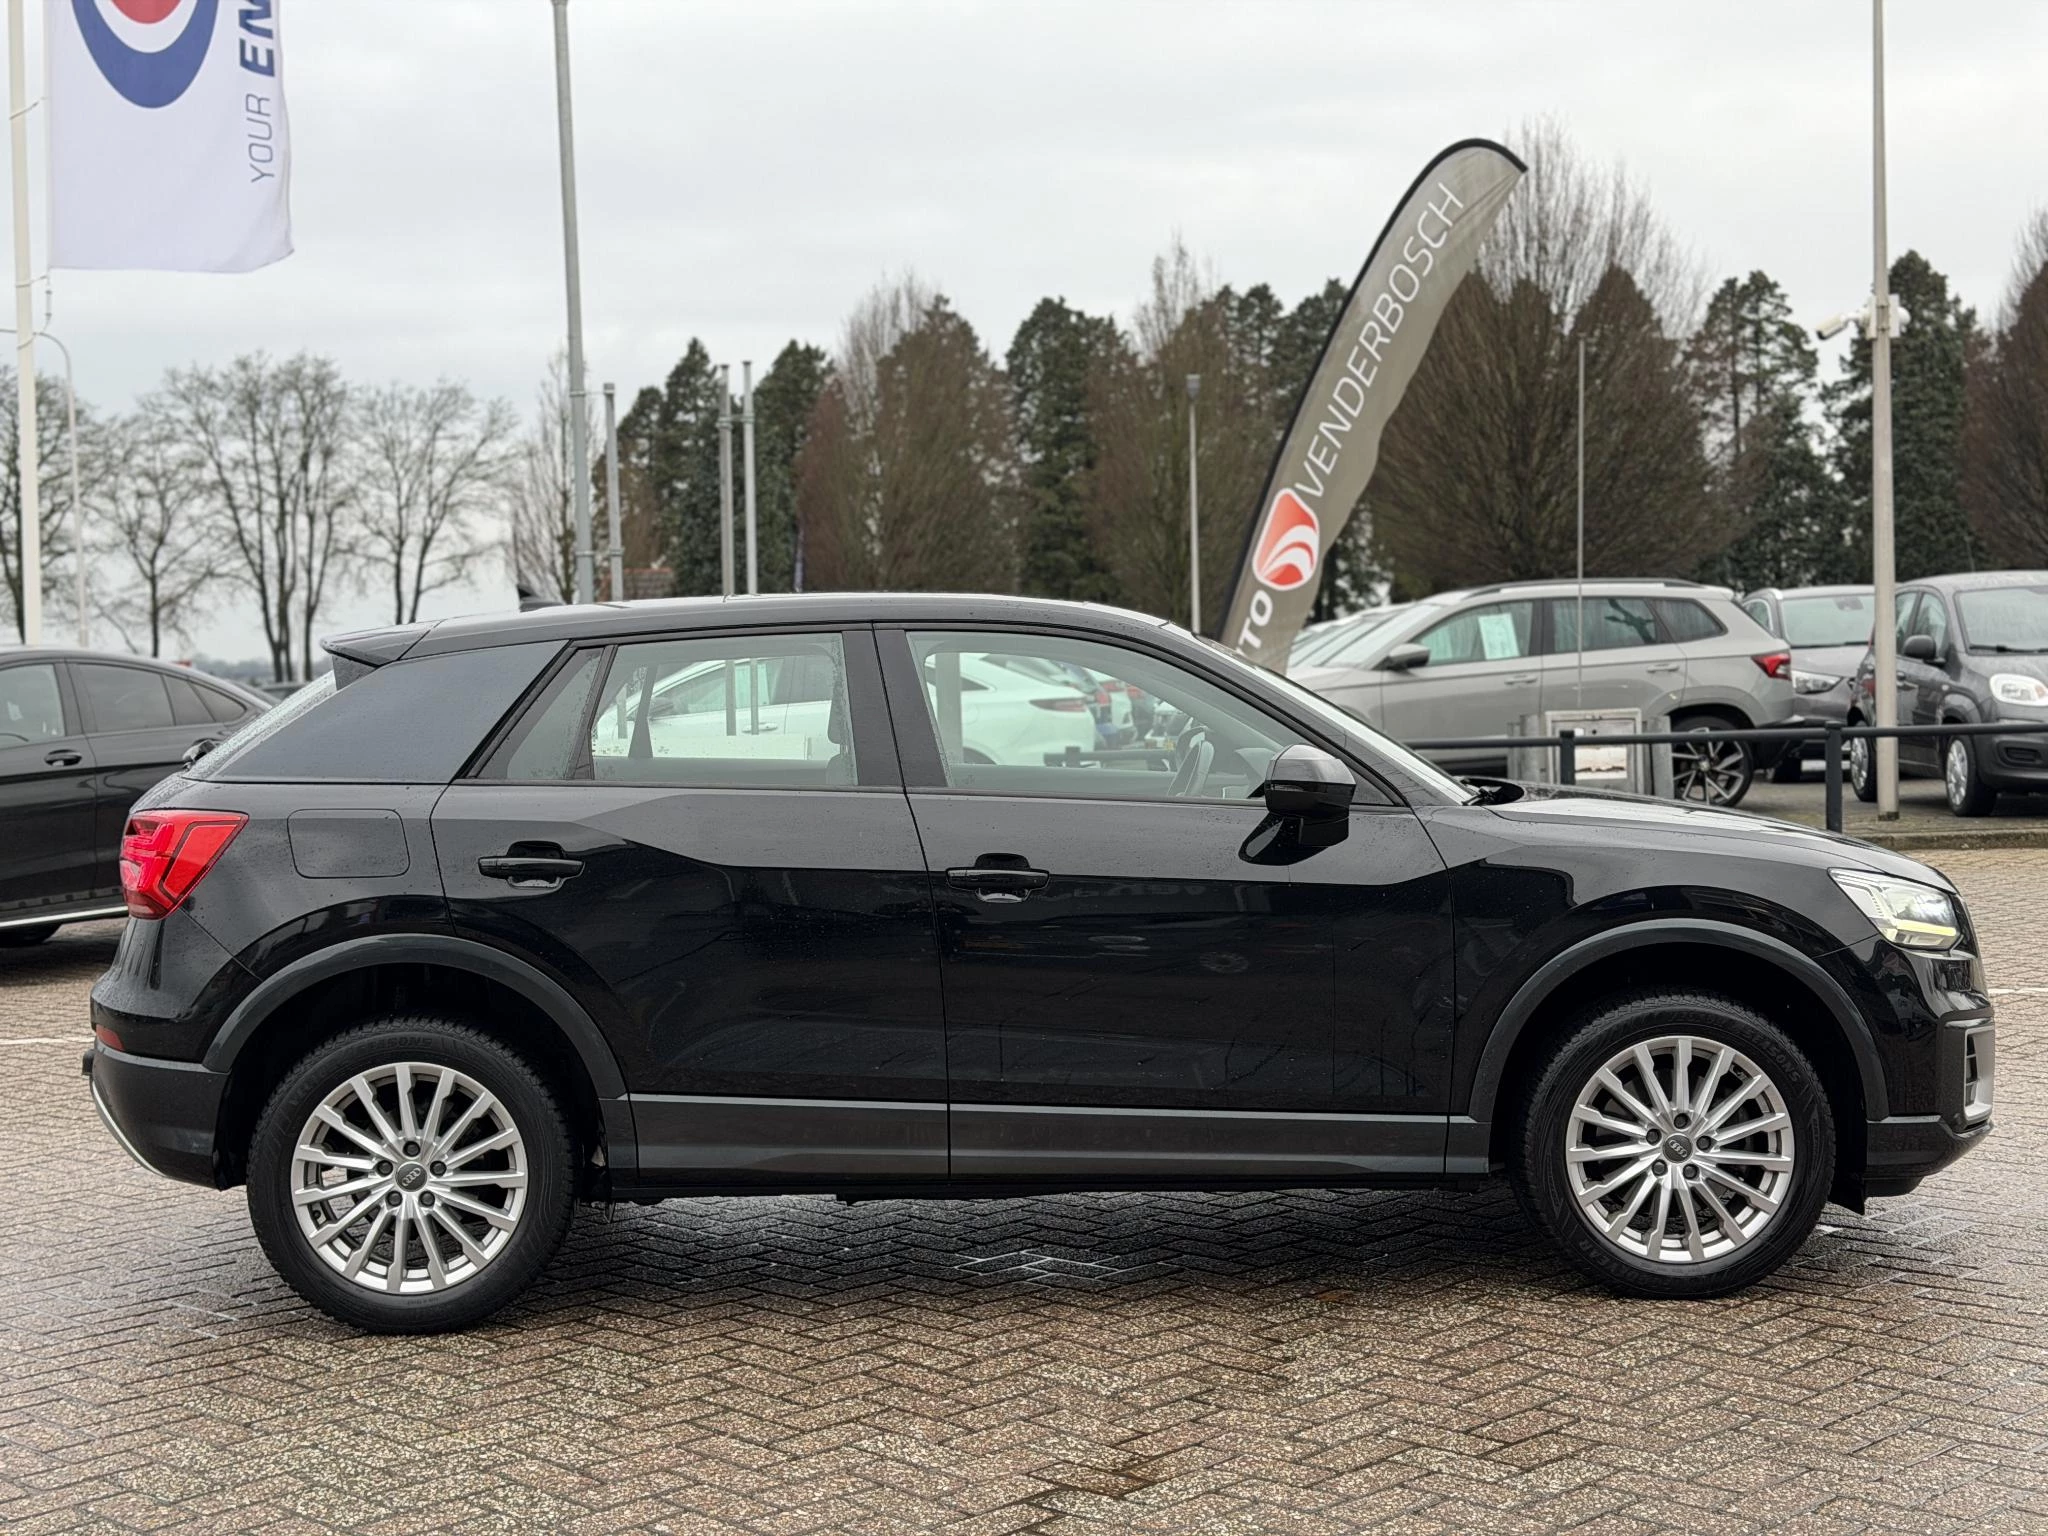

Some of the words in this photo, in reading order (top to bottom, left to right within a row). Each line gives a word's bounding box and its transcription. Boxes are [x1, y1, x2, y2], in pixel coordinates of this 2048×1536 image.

[245, 93, 275, 182] YOUR
[1235, 589, 1273, 656] TO
[1294, 182, 1464, 497] VENDERBOSCH
